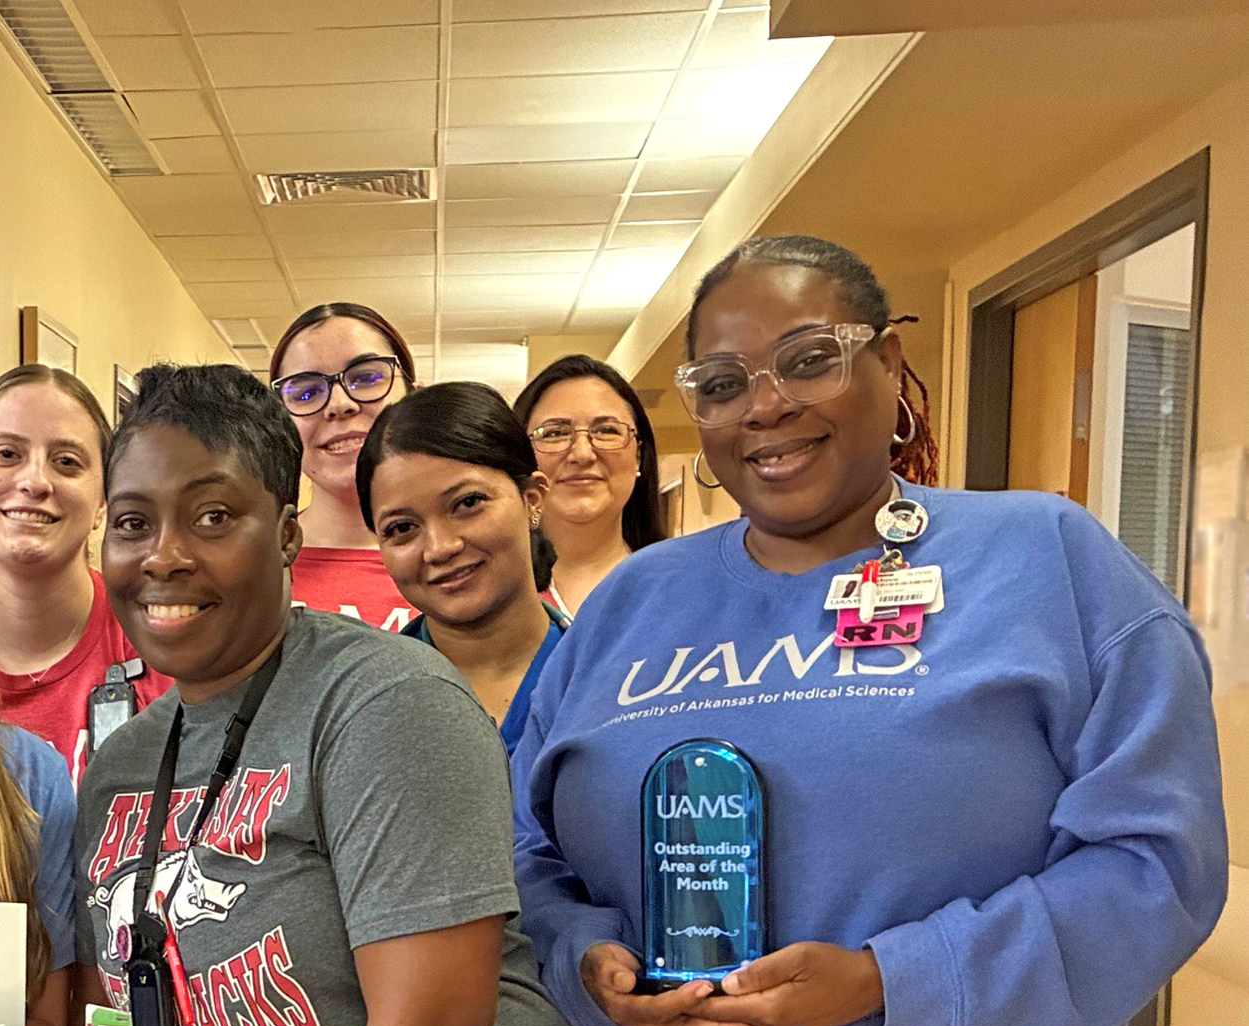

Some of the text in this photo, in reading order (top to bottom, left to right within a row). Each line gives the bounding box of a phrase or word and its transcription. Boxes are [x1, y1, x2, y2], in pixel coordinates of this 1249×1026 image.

[841, 622, 916, 643] RN
[669, 701, 686, 714] of
[686, 693, 754, 713] Arkansas
[758, 692, 780, 704] for
[782, 685, 842, 702] Medical
[845, 684, 916, 697] Sciences
[656, 795, 743, 819] UAMS
[654, 842, 751, 857] Outstanding
[659, 860, 746, 873] Area of the
[676, 877, 729, 890] Month
